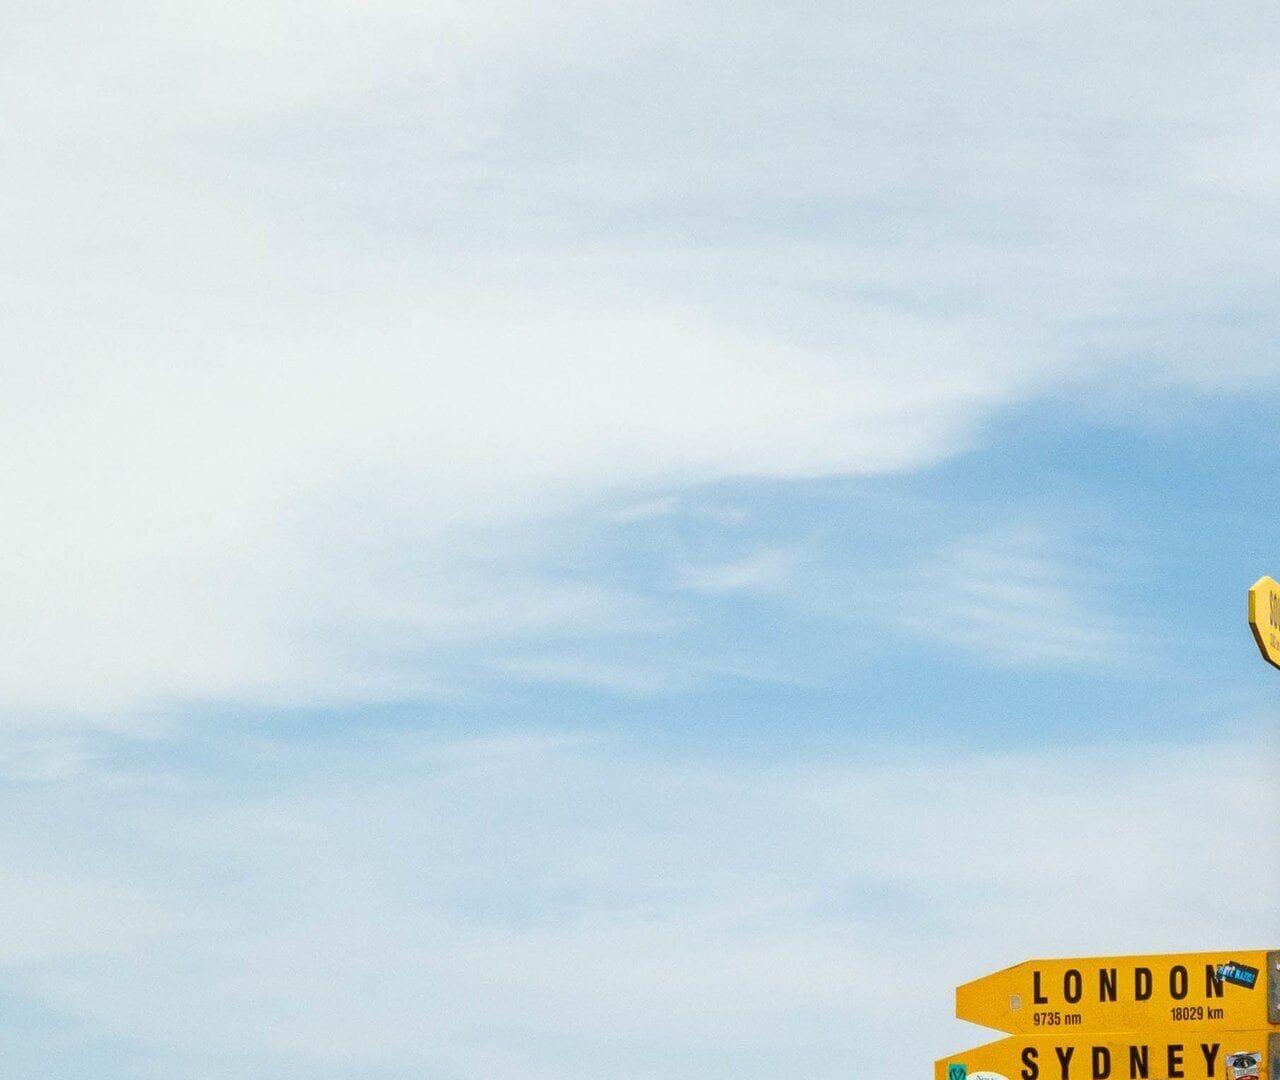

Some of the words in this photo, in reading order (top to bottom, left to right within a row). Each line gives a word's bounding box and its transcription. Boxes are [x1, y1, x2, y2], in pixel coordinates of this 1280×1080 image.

[1033, 964, 1224, 1005] LONDON
[1033, 1011, 1061, 1026] 9735
[1064, 1012, 1082, 1025] nm
[1170, 1006, 1204, 1021] 18029
[1207, 1006, 1224, 1020] km
